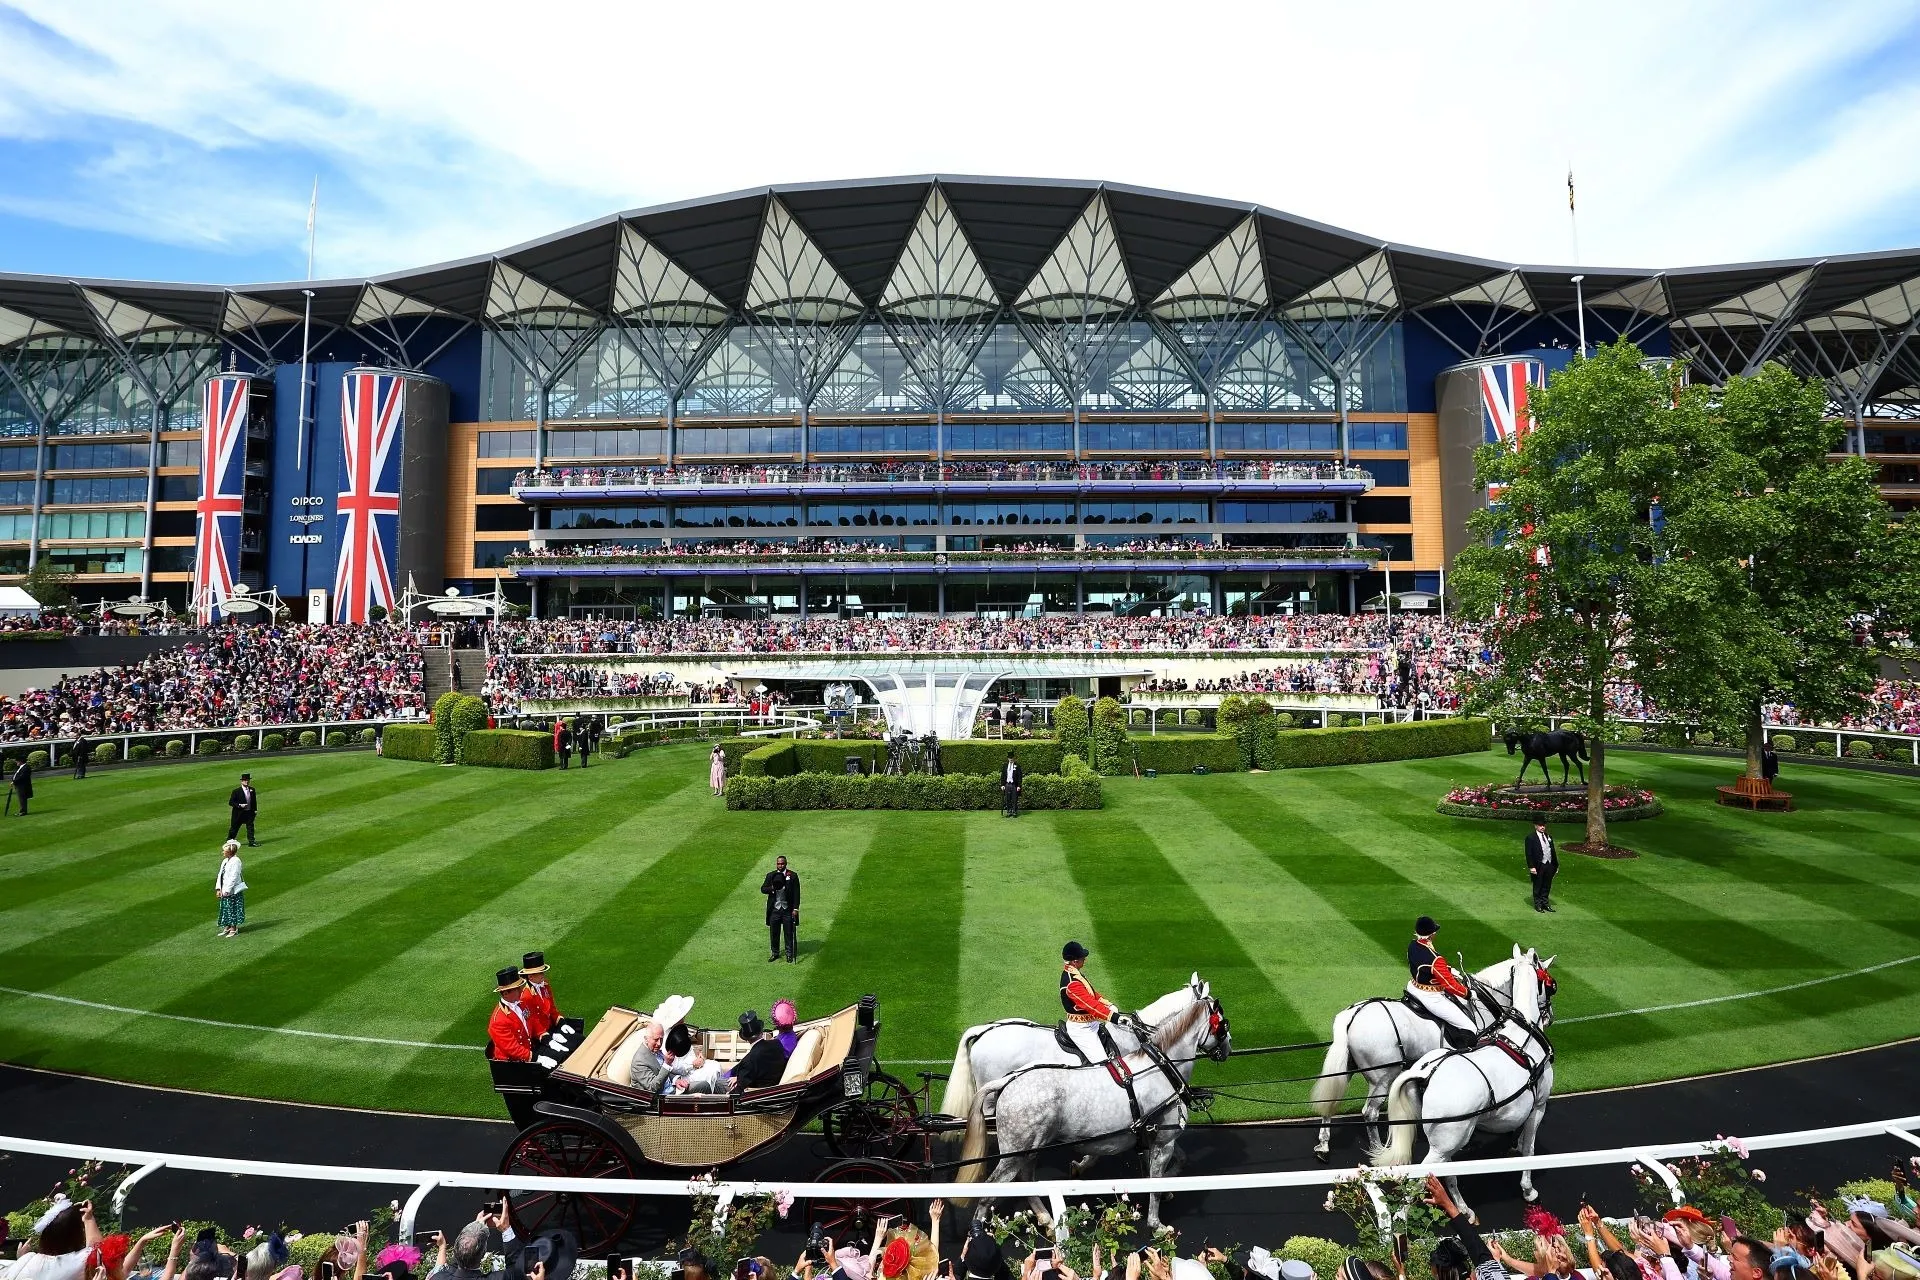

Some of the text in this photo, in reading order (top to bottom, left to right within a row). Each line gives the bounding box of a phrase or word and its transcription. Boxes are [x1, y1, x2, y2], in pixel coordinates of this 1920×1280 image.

[291, 496, 323, 506] QIPCO
[290, 535, 322, 543] HOWDEN
[313, 595, 321, 607] B
